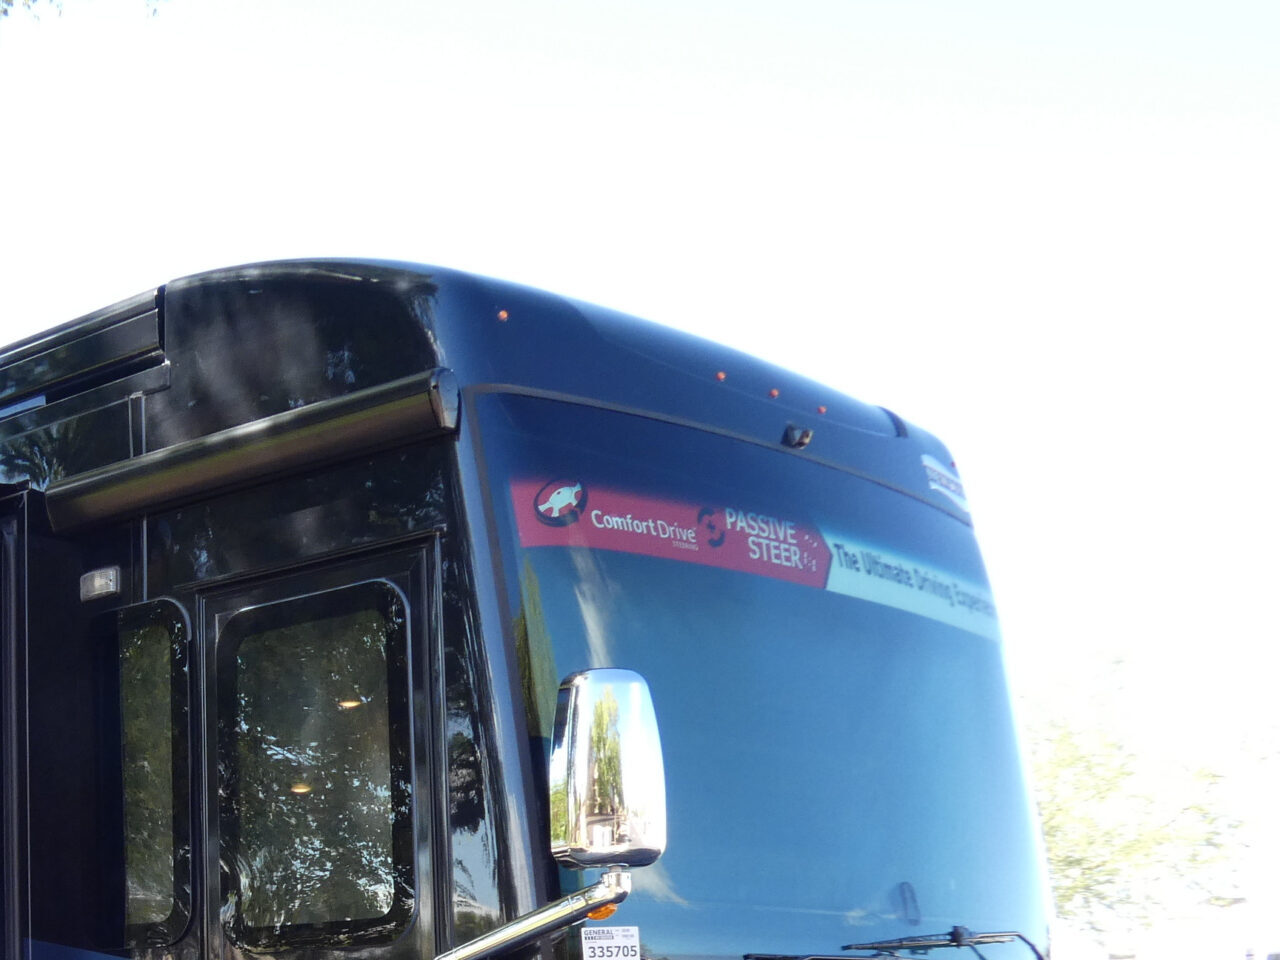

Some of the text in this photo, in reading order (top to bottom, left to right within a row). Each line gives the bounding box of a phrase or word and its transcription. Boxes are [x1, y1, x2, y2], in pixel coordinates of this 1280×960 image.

[725, 507, 797, 544] PASSIVE
[748, 536, 803, 570] STEER
[833, 542, 861, 573] The
[860, 550, 915, 589] Ultimate
[588, 945, 638, 958] 335705
